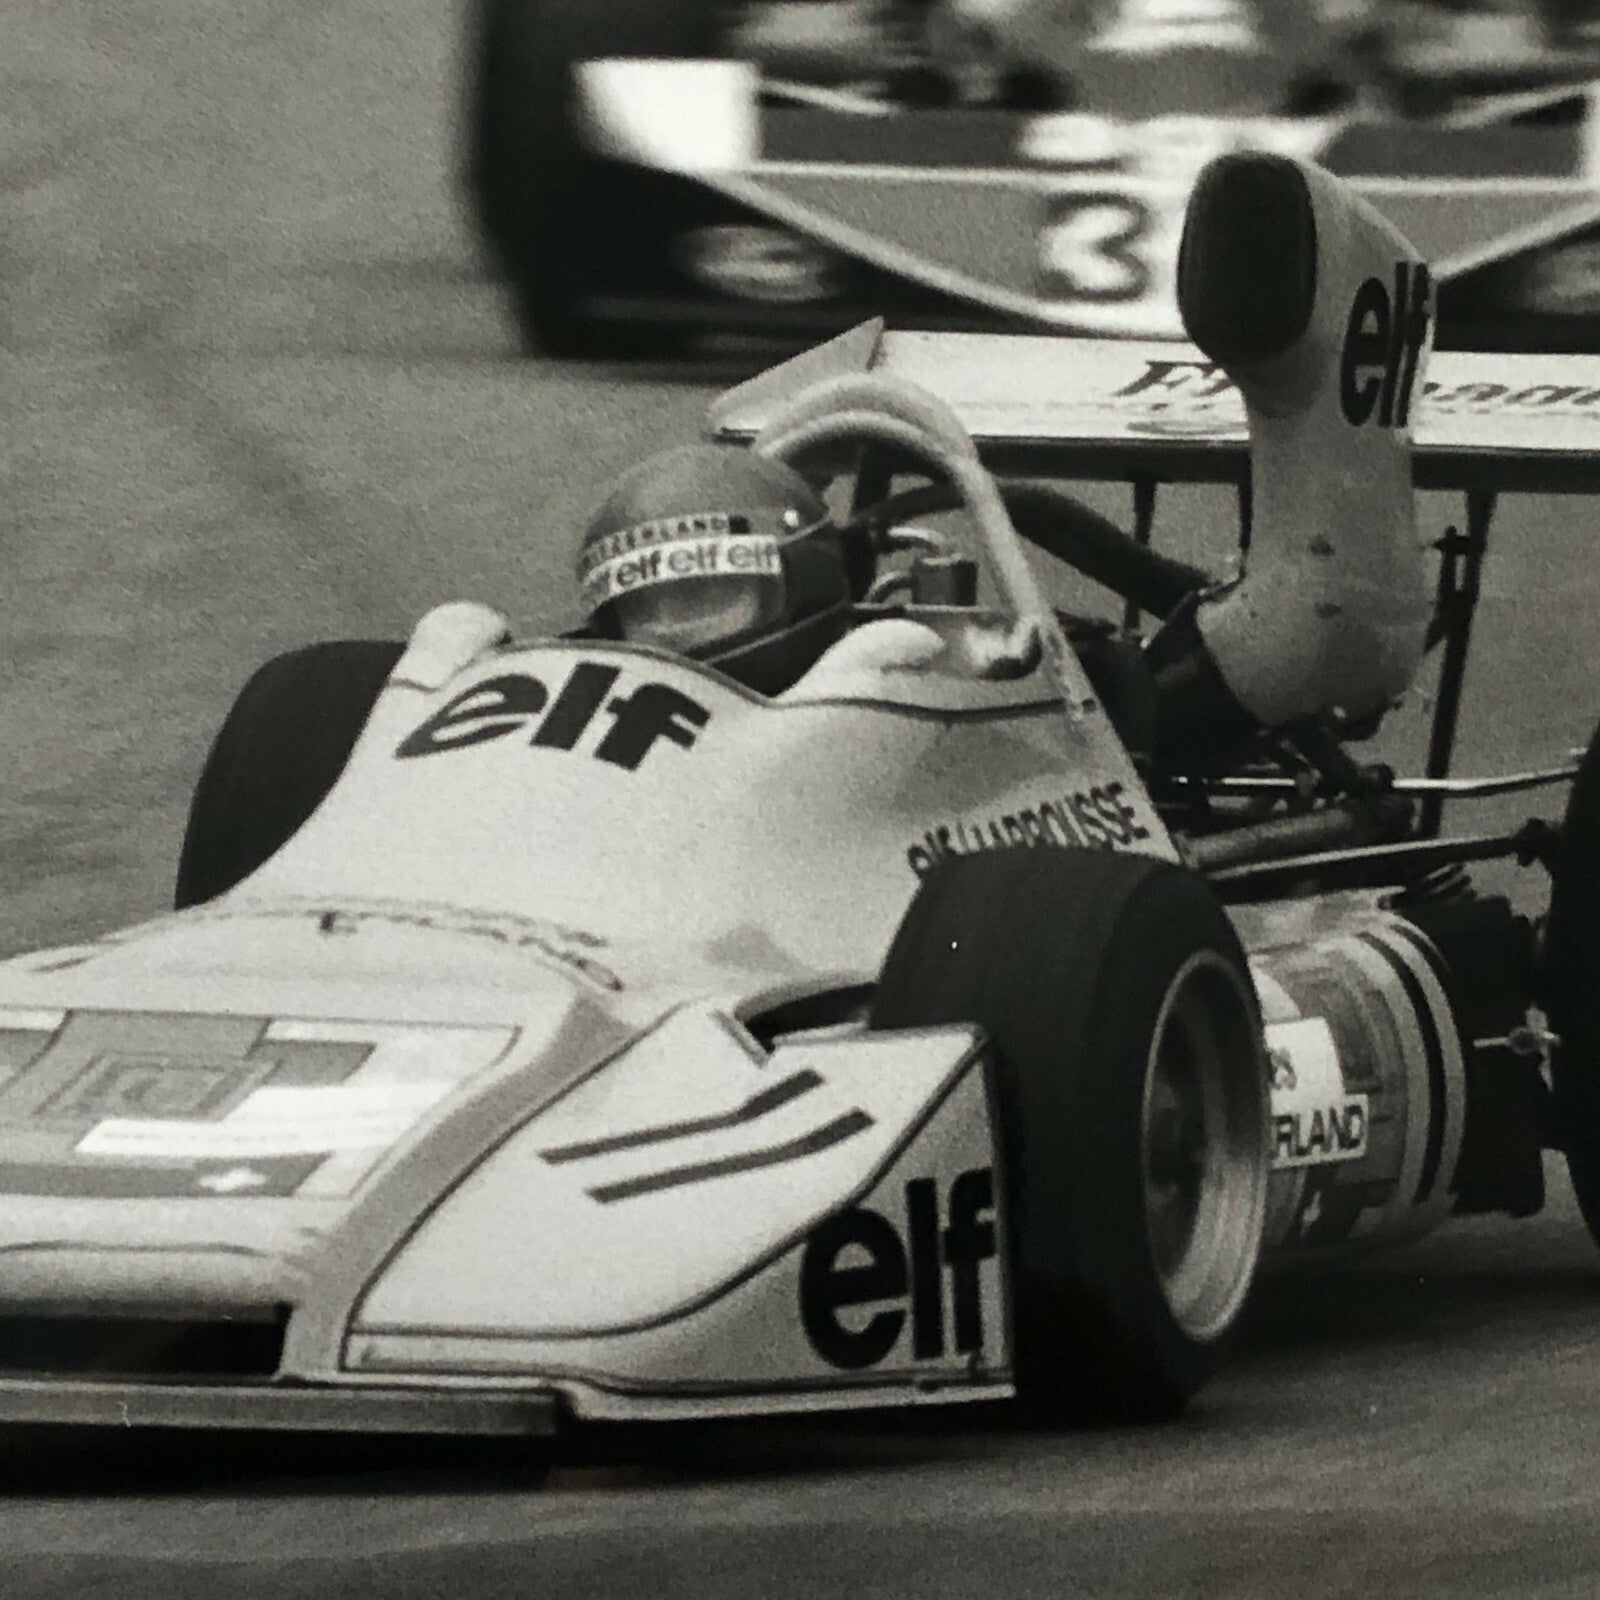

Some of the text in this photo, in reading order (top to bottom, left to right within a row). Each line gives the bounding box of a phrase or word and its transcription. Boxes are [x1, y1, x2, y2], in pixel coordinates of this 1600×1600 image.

[1037, 191, 1150, 302] 3
[1340, 261, 1430, 428] elf
[616, 549, 661, 587] elf
[668, 543, 717, 574] elf
[727, 541, 780, 568] elf
[394, 661, 710, 771] elf
[1270, 1103, 1363, 1157] RLAND
[799, 1166, 998, 1370] elf
